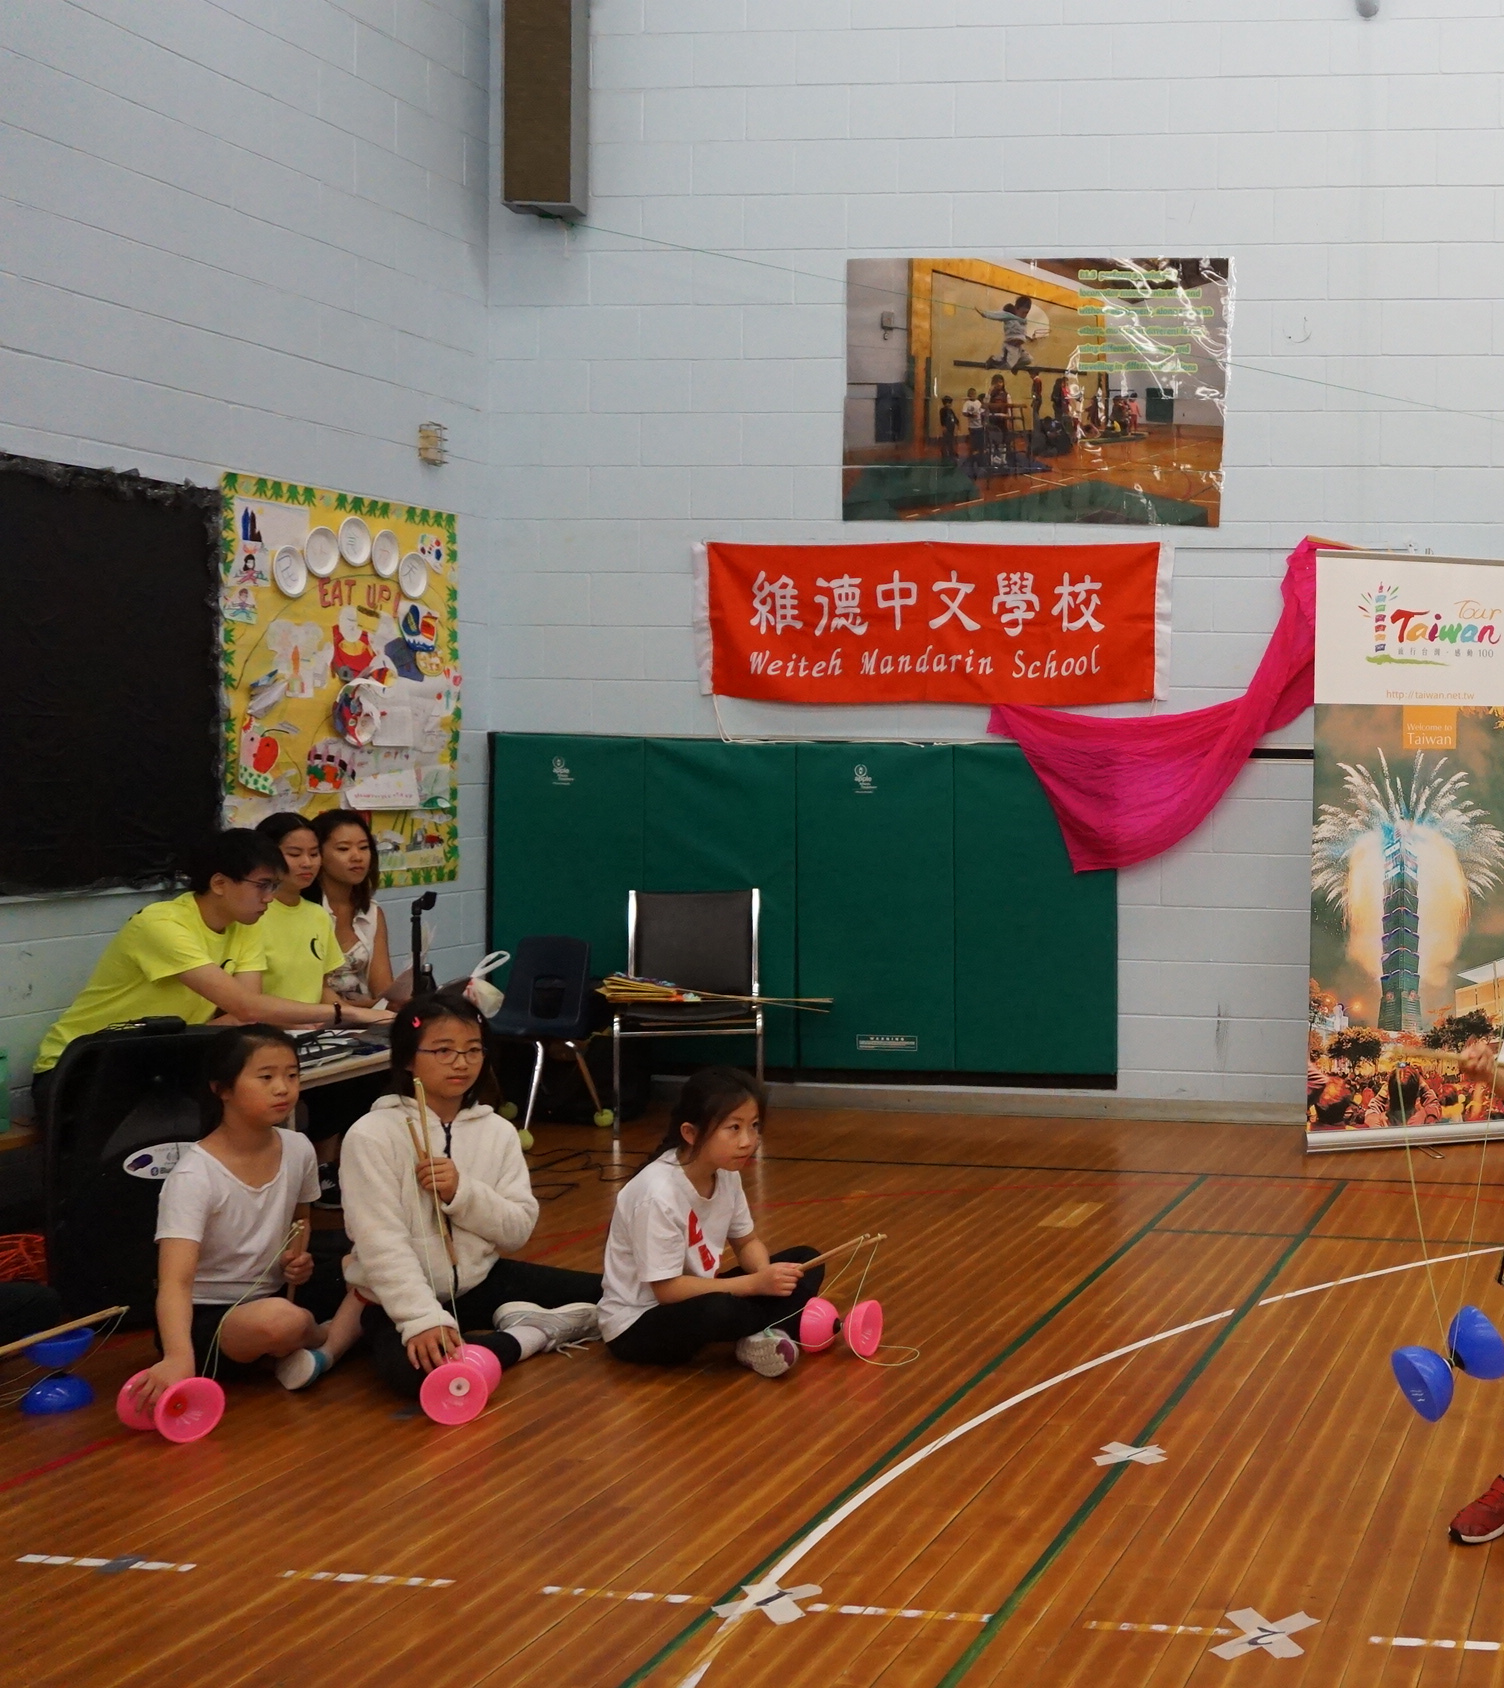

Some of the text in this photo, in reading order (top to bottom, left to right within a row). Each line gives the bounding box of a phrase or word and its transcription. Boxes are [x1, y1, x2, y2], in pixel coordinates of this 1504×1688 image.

[318, 577, 357, 607] EAT
[750, 569, 1106, 637] 維德中文學校
[1454, 600, 1502, 621] Tour
[1390, 609, 1502, 645] Taiwan
[750, 644, 1101, 678] Weiteh Mandarin School
[1386, 690, 1475, 700] http://taiwan.net.tw
[1407, 723, 1453, 732] Welcome to
[1407, 732, 1453, 746] Taiwan
